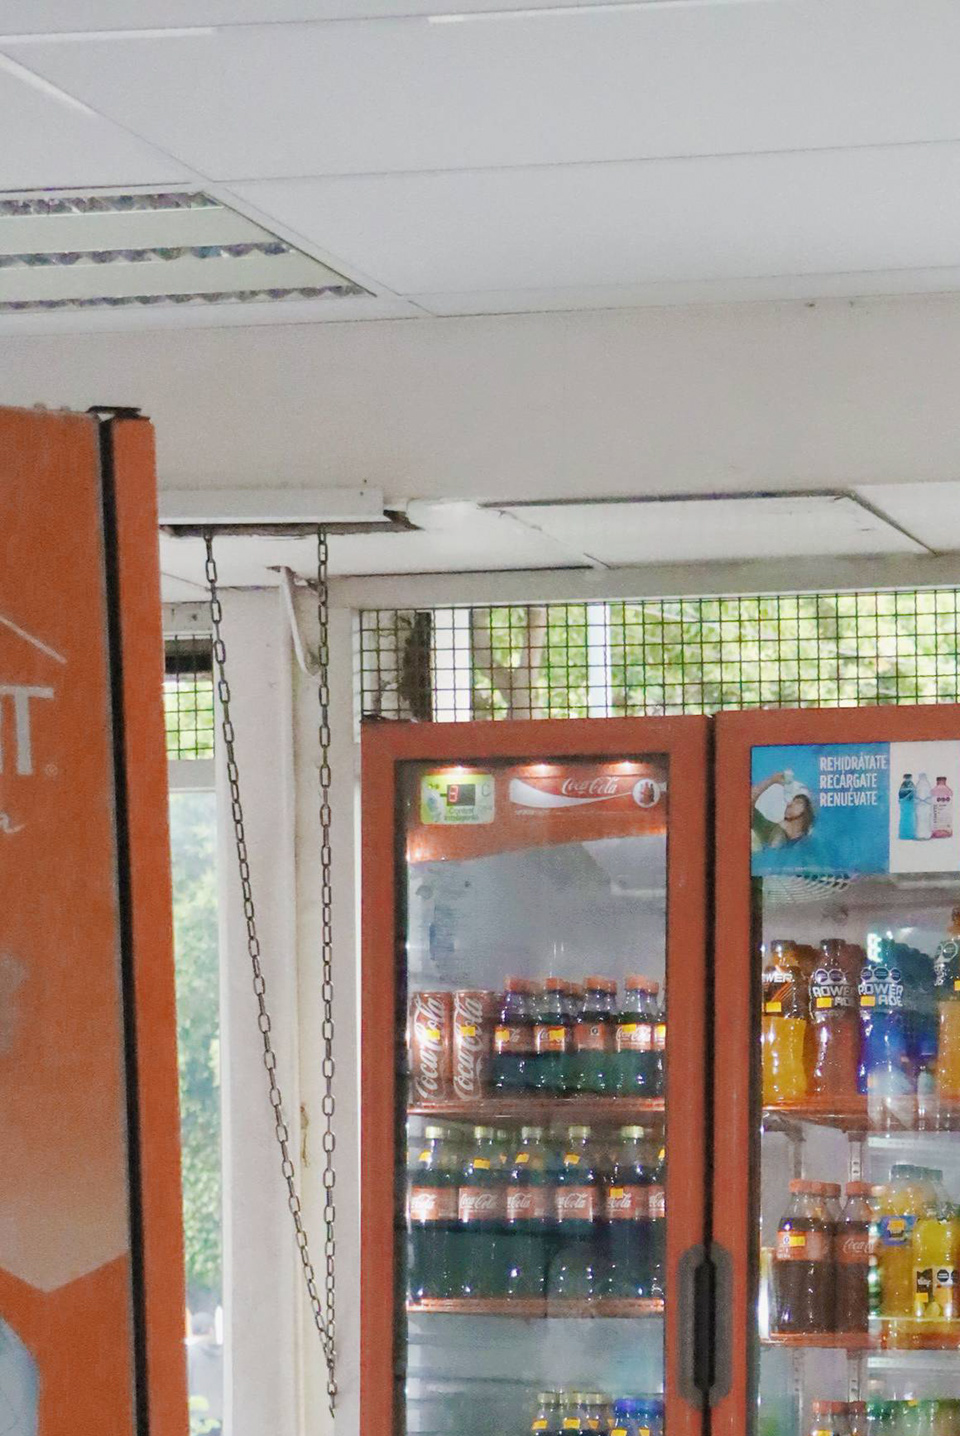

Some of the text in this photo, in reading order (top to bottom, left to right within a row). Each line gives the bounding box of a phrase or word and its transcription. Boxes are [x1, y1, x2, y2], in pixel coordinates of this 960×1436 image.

[819, 752, 888, 771] REHIDRÁTATE
[819, 770, 878, 789] RECÁRGATE
[819, 788, 878, 807] RENUÉVATE
